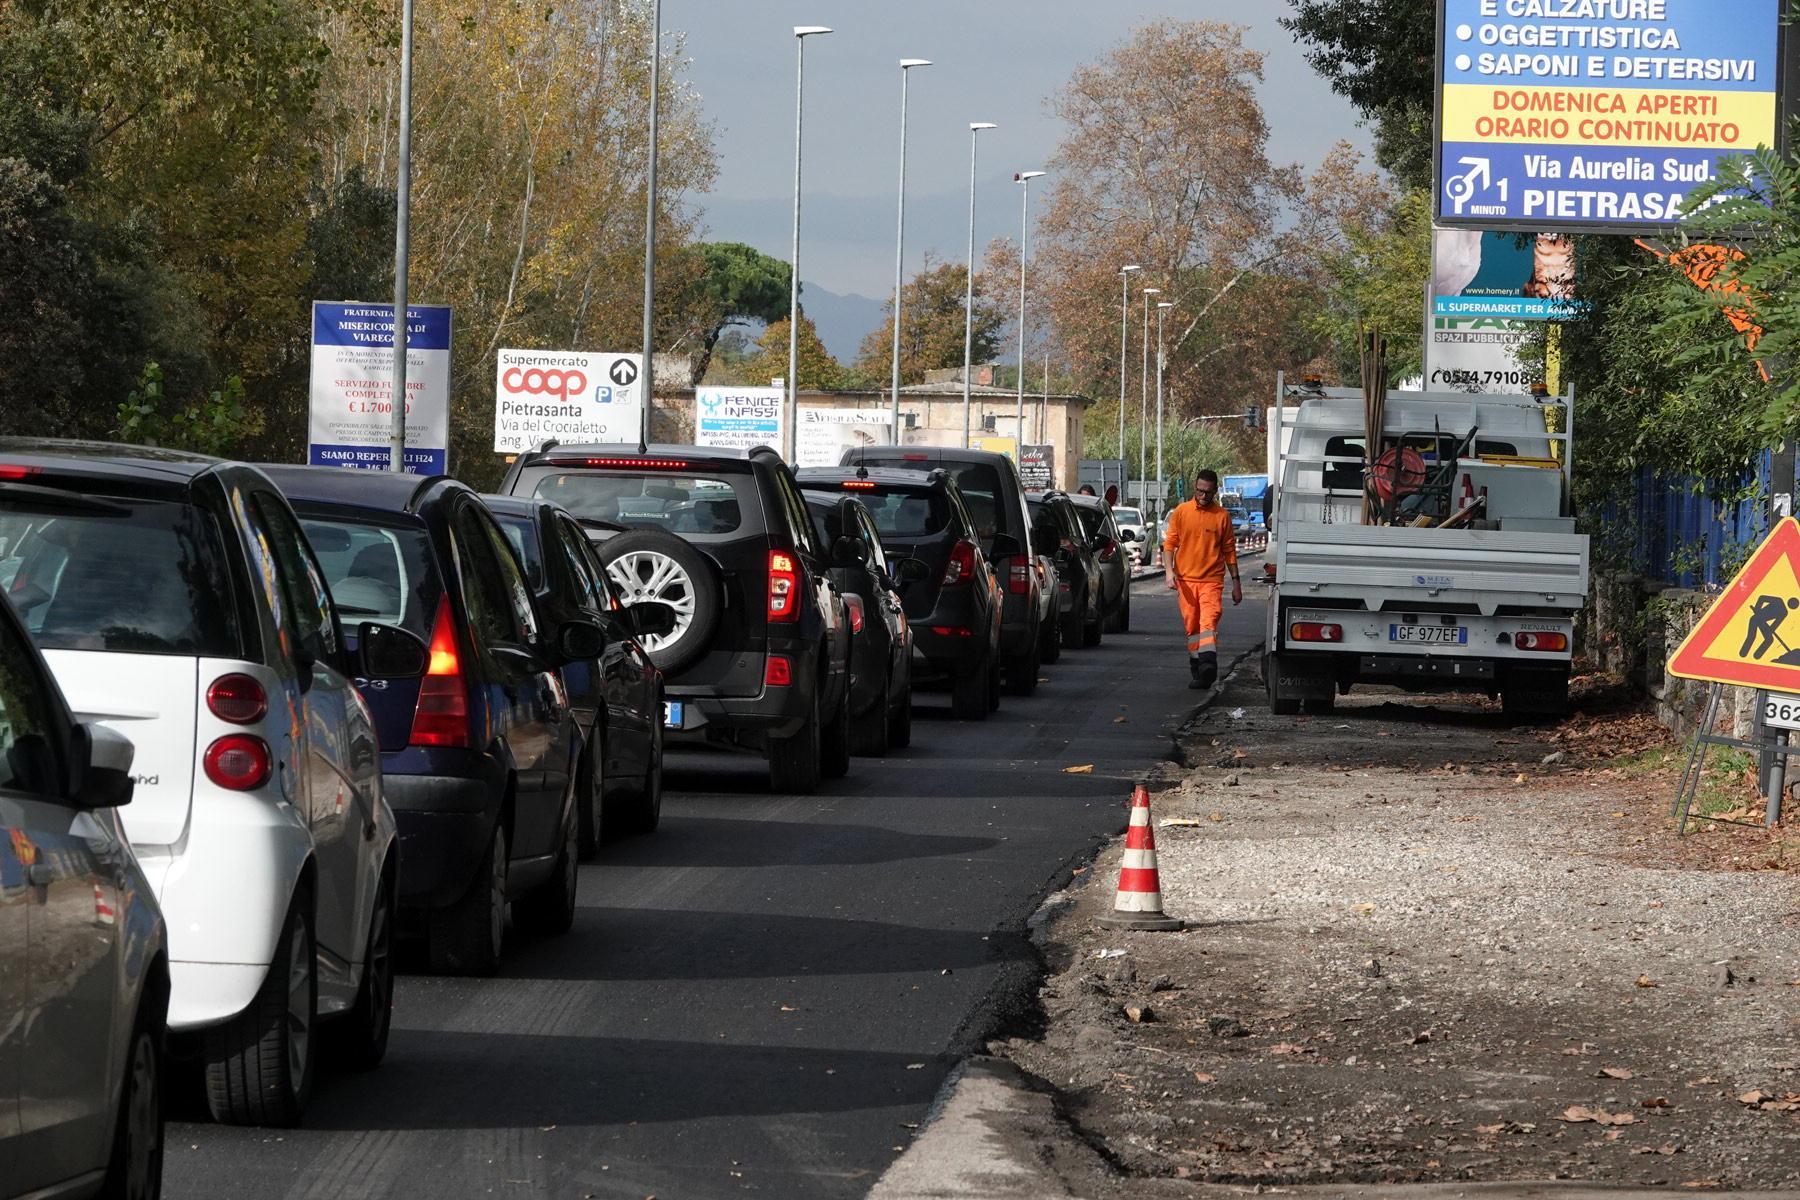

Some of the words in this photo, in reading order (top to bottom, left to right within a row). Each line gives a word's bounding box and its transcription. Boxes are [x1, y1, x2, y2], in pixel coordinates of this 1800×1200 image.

[1480, 0, 1498, 17] E
[1505, 0, 1667, 20] CALZATURE
[1479, 24, 1680, 50] OGGETTISTICA
[1477, 53, 1579, 77] SAPONI
[1588, 56, 1606, 77] E
[1613, 57, 1756, 82] DETERSIVI
[1493, 90, 1627, 114] DOMENICA
[1636, 94, 1718, 117] APERTI
[1475, 116, 1570, 139] ORARIO
[1579, 118, 1740, 144] CONTINUATO
[1524, 154, 1562, 179] Via
[1568, 157, 1655, 182] Aurelia
[1662, 158, 1716, 183] Sud.
[1496, 177, 1509, 202] 1
[1470, 204, 1507, 216] MINUTO
[1523, 189, 1745, 222] PIETRASA
[1465, 287, 1520, 296] www.homery.it
[1437, 303, 1446, 312] IL
[1448, 303, 1522, 314] SUPERMARKET
[1525, 305, 1544, 314] PER
[338, 321, 416, 333] MISERICORA
[416, 324, 426, 333] DI
[353, 333, 411, 343] VIAREG
[1435, 332, 1464, 342] SPAZI
[503, 354, 588, 367] Supermercato
[335, 379, 379, 389] SERVIZIO
[381, 381, 426, 391] FUBRE
[502, 367, 588, 402] coop
[345, 390, 393, 399] COMPLET
[725, 396, 780, 407] FENICE
[502, 401, 582, 417] Pietrasanta
[724, 407, 778, 418] INFISSI
[501, 418, 519, 431] Via
[522, 419, 540, 432] del
[543, 420, 607, 433] Crocialetto
[500, 436, 525, 449] ang.
[321, 451, 355, 460] SIAMO
[356, 452, 414, 463] REPERLI
[415, 455, 433, 463] H24
[1520, 623, 1562, 631] RENAULT
[1399, 626, 1414, 640] GF
[1418, 627, 1458, 642] 977EF
